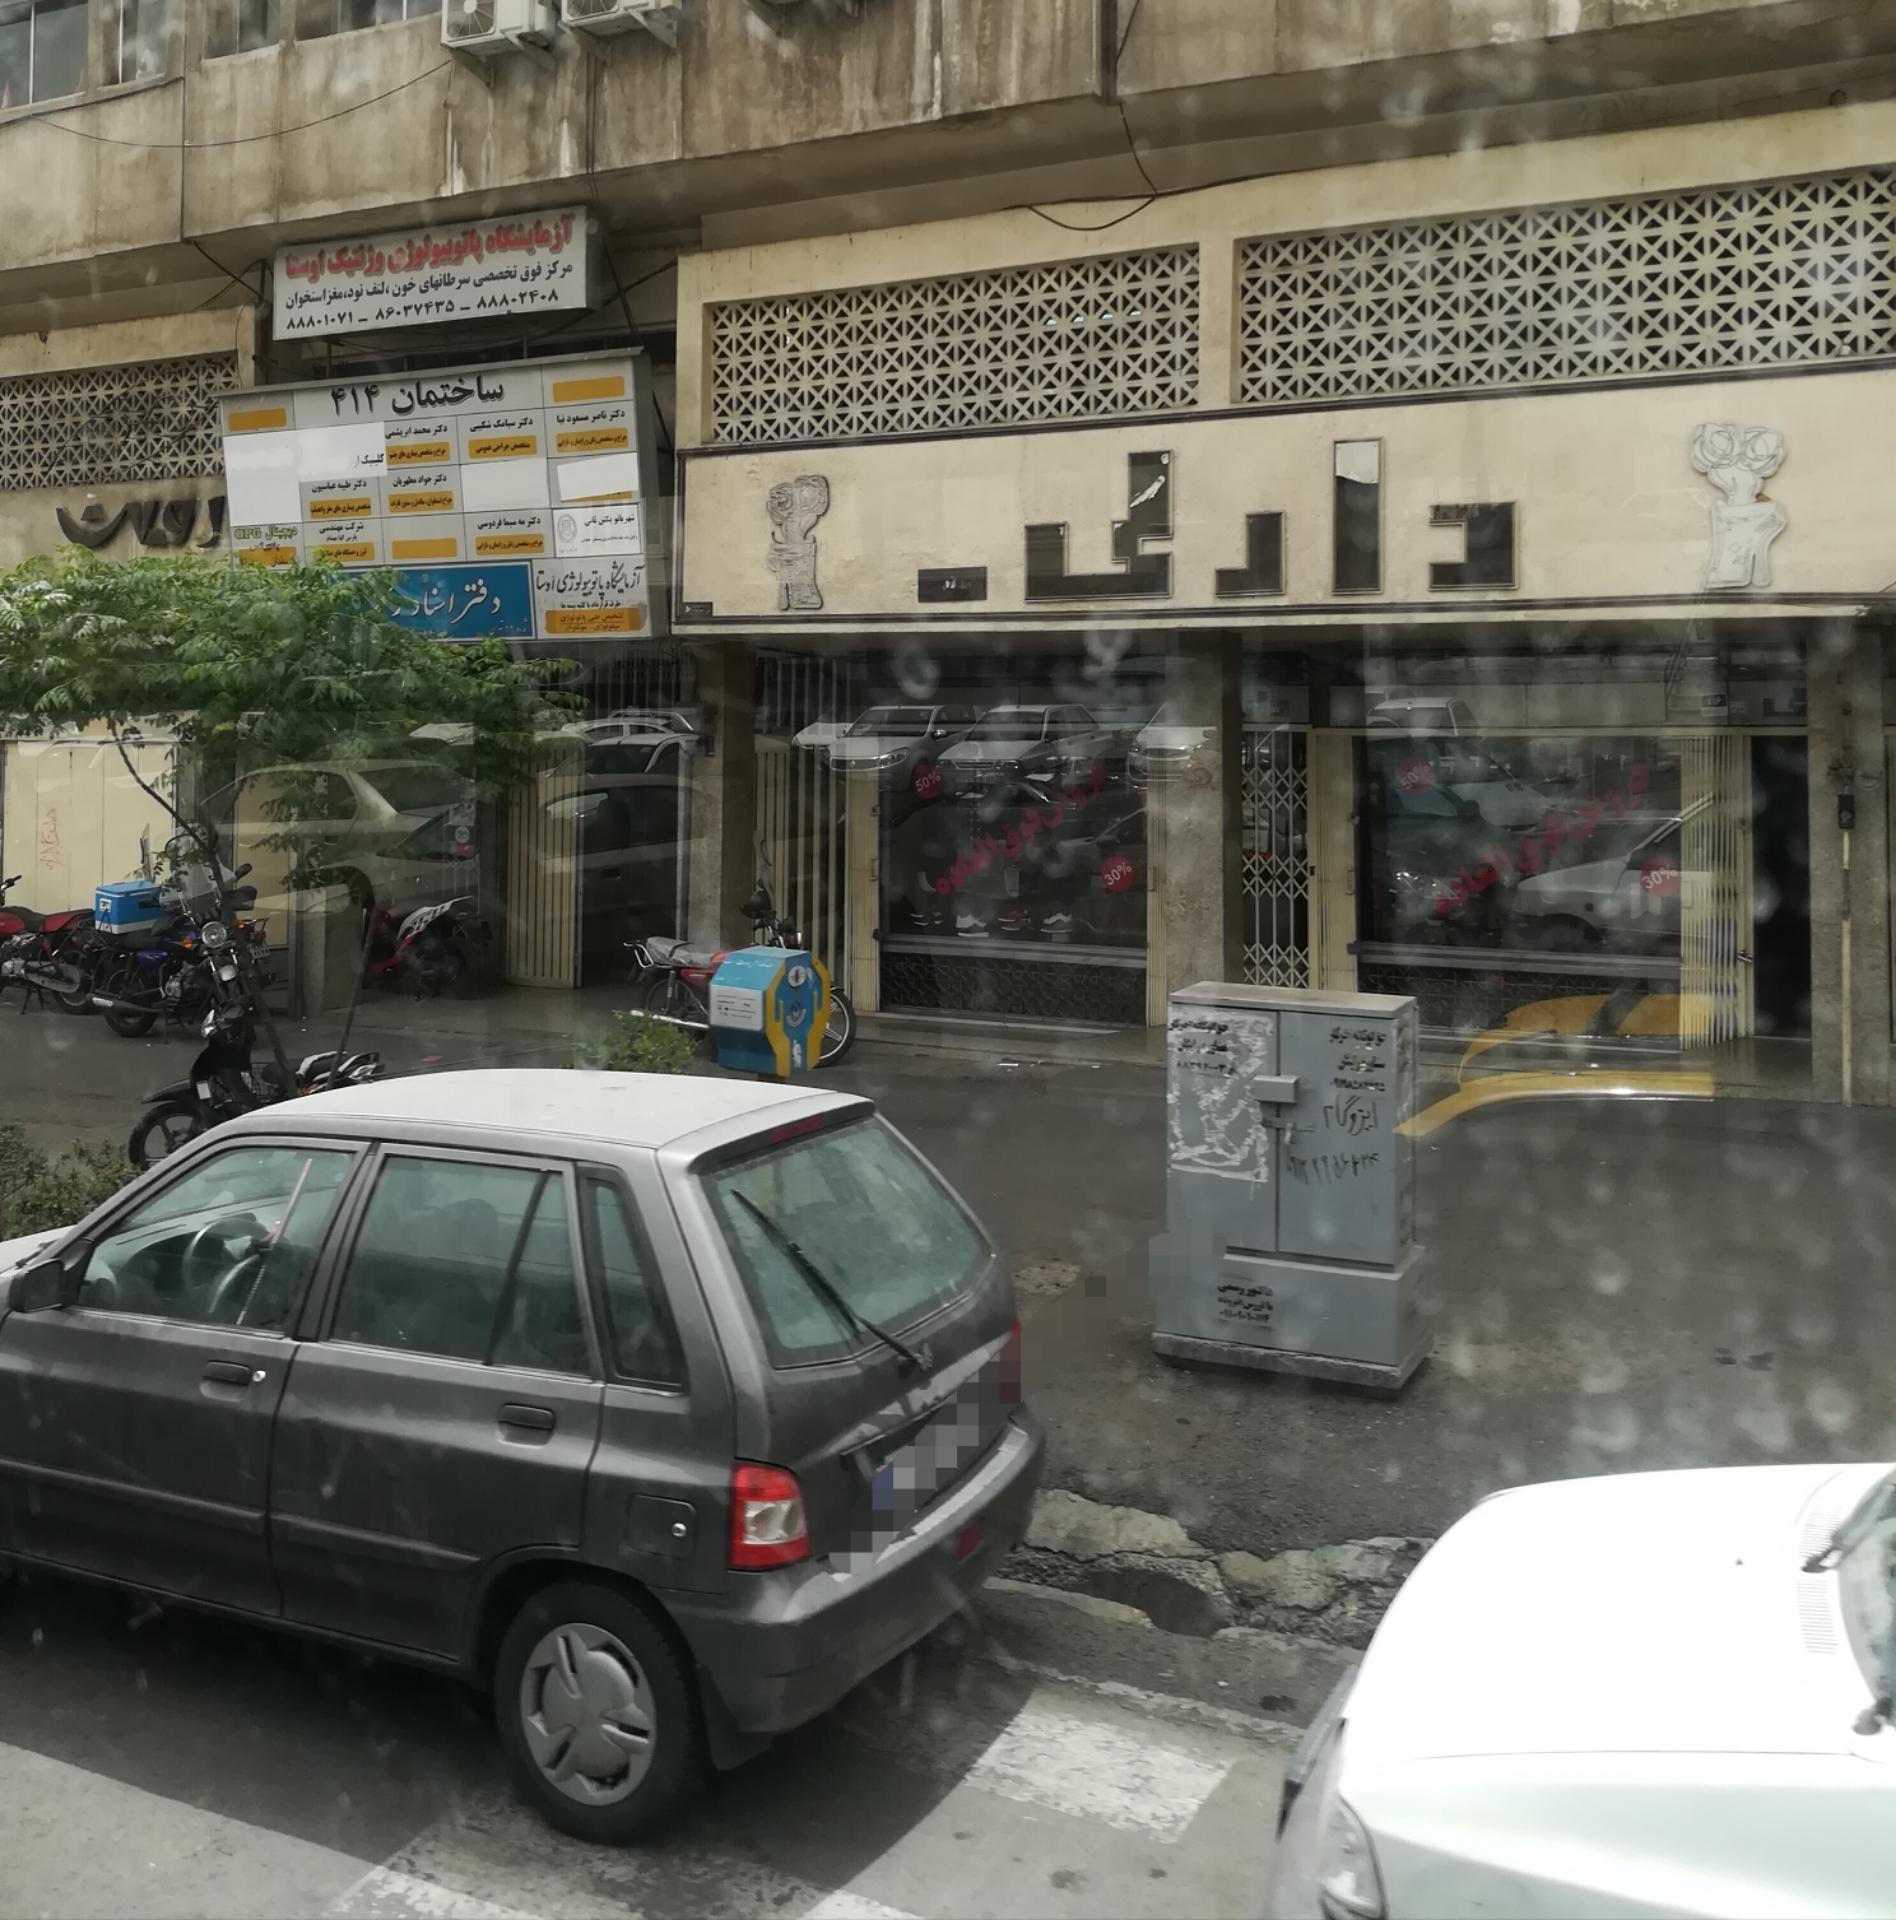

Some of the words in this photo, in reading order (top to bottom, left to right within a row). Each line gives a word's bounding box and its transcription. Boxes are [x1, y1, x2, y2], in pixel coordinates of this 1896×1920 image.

[486, 212, 576, 256] آزمایشگاه
[285, 248, 326, 284] اوستا
[473, 264, 518, 288] تخصصی
[520, 260, 543, 283] فوق
[545, 260, 573, 280] مرکز
[392, 276, 416, 298] خون
[477, 287, 559, 310] ۸۸۸۰۲۴۰۸
[286, 310, 354, 331] ۸۸۸۰۱۰۷۱
[375, 299, 455, 321] ۸۶۰۳۷۴۳۵
[330, 383, 381, 417] ۴۱۴
[392, 373, 505, 416] ساختمان
[517, 417, 533, 429] دکتر
[591, 410, 608, 423] ناصر
[609, 409, 626, 422] دکتر
[413, 426, 431, 435] محمد
[433, 424, 448, 436] دکتر
[353, 479, 367, 491] دکتر
[418, 473, 432, 487] جواد
[434, 473, 448, 486] دکتر
[234, 527, 262, 540] OPG
[345, 521, 364, 533] شرکت
[478, 517, 503, 530] فردوسی
[527, 517, 541, 528] دکتر
[536, 570, 555, 592] اوستا
[556, 570, 605, 597] پاتوبیولوژی
[606, 561, 646, 594] آزمایشگاه
[450, 578, 501, 624] دفتر
[915, 771, 941, 793] 50%
[1400, 762, 1432, 790] 50%
[1104, 862, 1132, 887] 30%
[1641, 868, 1679, 890] 30%
